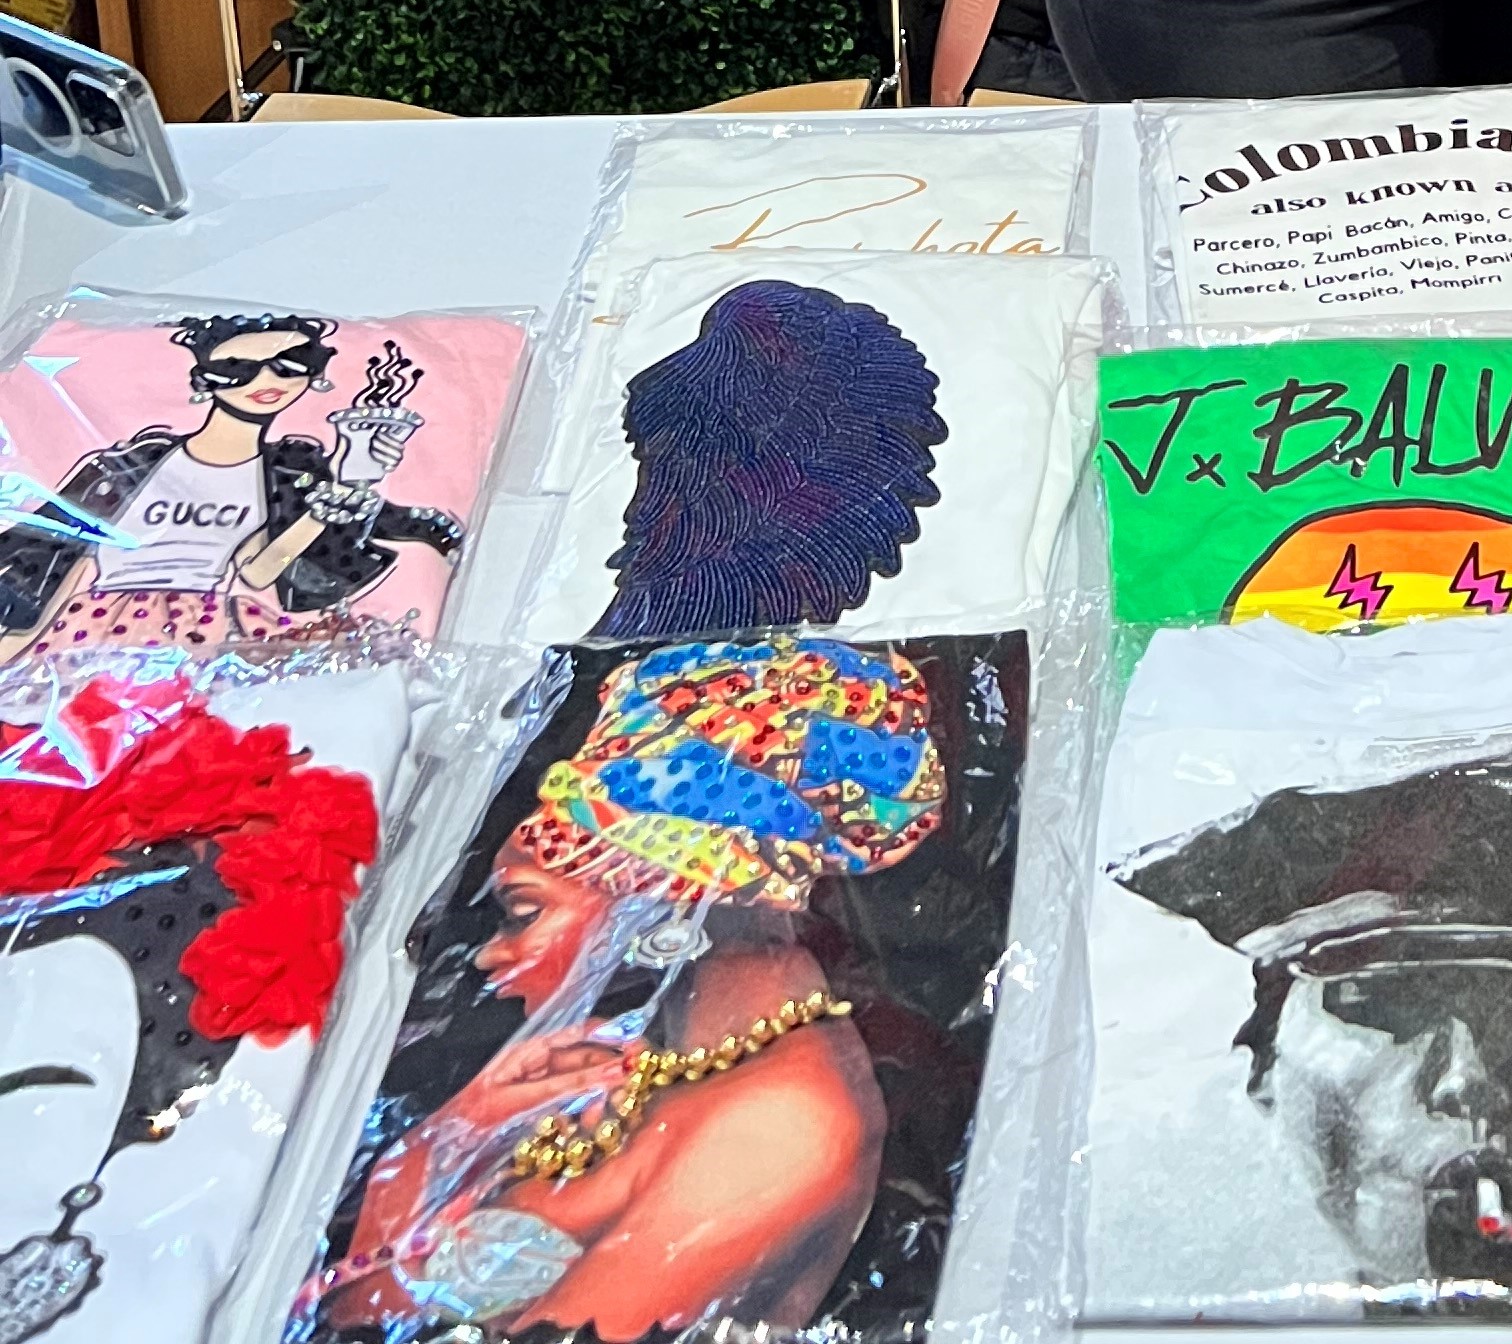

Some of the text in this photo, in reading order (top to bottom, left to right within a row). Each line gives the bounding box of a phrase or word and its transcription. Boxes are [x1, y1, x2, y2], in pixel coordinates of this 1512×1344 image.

[1251, 197, 1327, 215] also
[1345, 178, 1477, 206] known
[1193, 237, 1281, 253] Parcero,
[1287, 224, 1333, 245] Papi
[1421, 209, 1491, 225] Amigo,
[1216, 259, 1306, 276] Chinazo,
[1312, 235, 1448, 265] Zumbambico,
[1454, 231, 1512, 245] Pinta,
[1399, 258, 1460, 273] Viejo,
[1318, 284, 1404, 304] Caspita,
[142, 498, 251, 530] GUCCI
